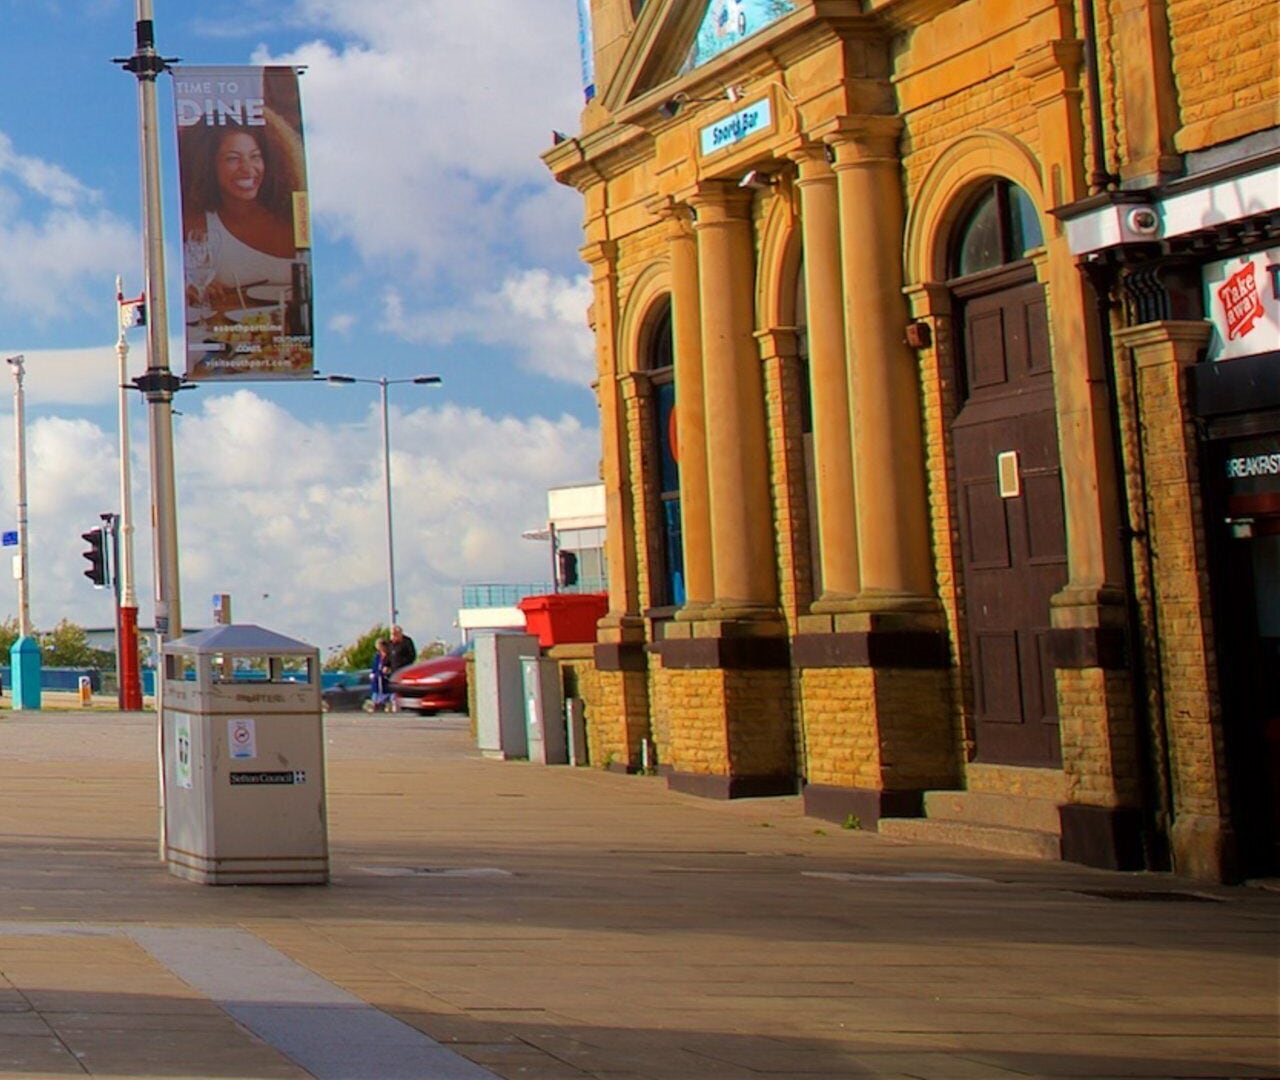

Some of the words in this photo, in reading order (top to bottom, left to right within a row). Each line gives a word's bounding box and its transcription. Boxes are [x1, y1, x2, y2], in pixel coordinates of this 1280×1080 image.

[176, 82, 211, 94] TIME
[218, 82, 238, 94] TO
[177, 99, 266, 126] DINE
[713, 118, 742, 145] Sports
[742, 111, 759, 132] Bar
[1221, 273, 1256, 309] Take
[1227, 291, 1259, 336] away
[260, 773, 293, 783] Council
